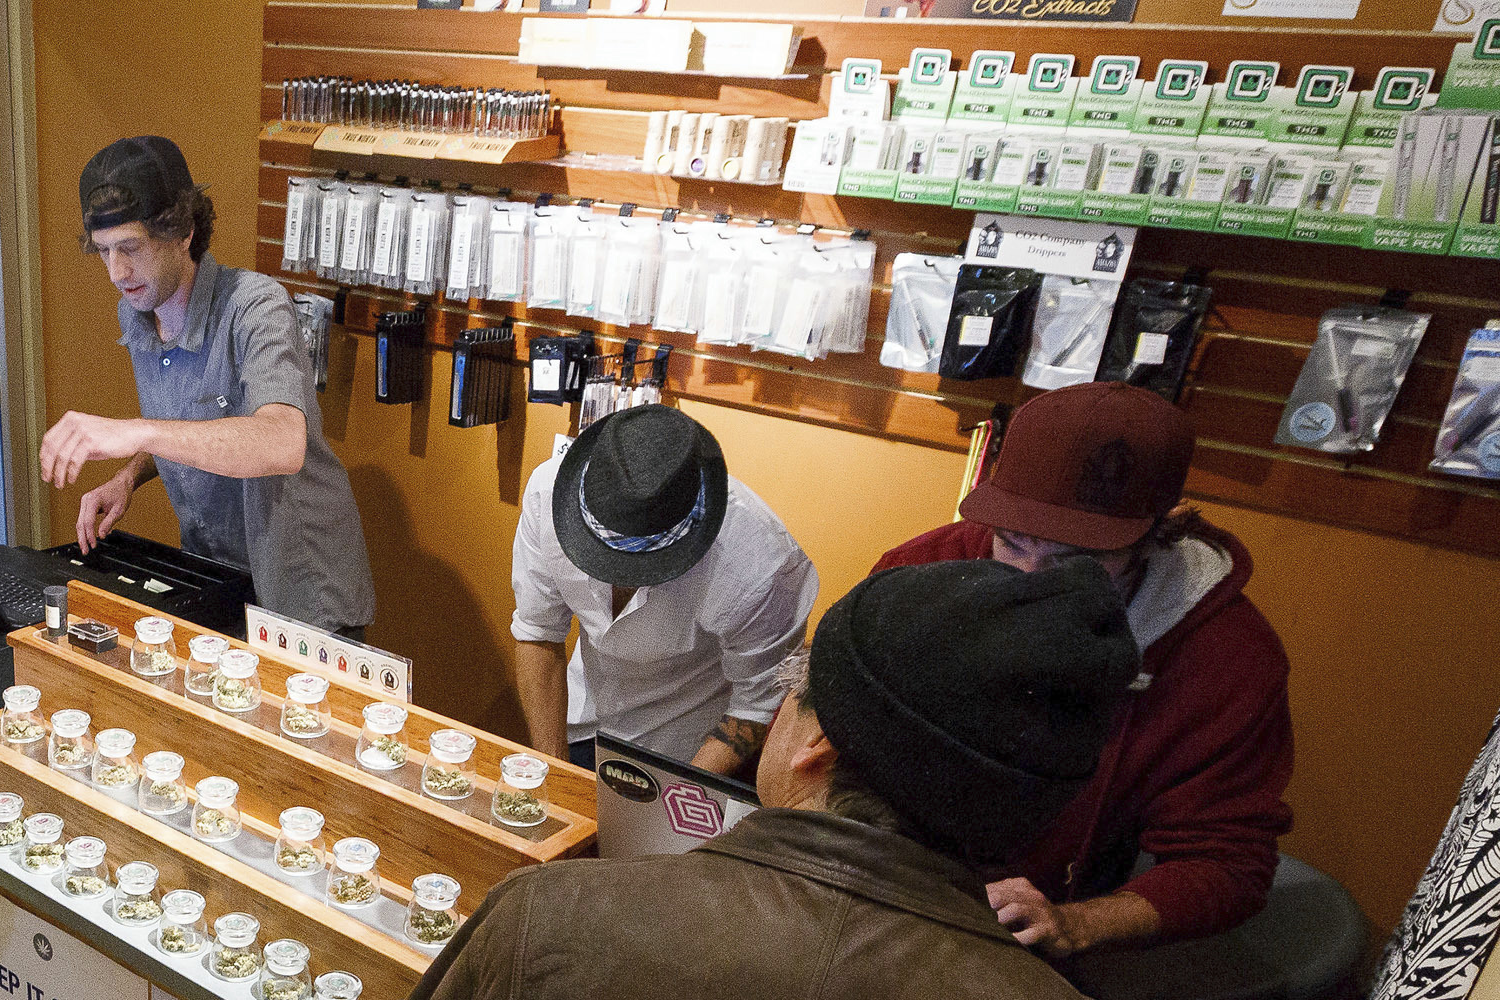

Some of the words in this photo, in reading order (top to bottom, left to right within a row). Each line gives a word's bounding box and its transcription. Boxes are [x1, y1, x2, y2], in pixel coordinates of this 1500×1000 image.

[970, 104, 989, 112] THC
[1030, 108, 1049, 116] THC
[1091, 111, 1112, 120] THC
[1155, 118, 1177, 126] THC
[1225, 119, 1247, 128] THC
[1294, 125, 1319, 135] THC
[1372, 129, 1397, 138] THC
[899, 192, 916, 200] THC
[958, 197, 976, 205] THC
[1018, 204, 1037, 212] THC
[1082, 208, 1102, 216] THC
[1149, 216, 1170, 224] THC
[1220, 221, 1241, 229] THC
[1294, 230, 1317, 239] THC
[1373, 228, 1411, 239] GREEN
[1413, 230, 1446, 241] LIGHT
[1040, 233, 1087, 247] Company
[1372, 237, 1409, 248] VAPE
[1412, 239, 1443, 249] PEN
[1027, 245, 1067, 257] Drippers
[1459, 243, 1497, 254] VAPE
